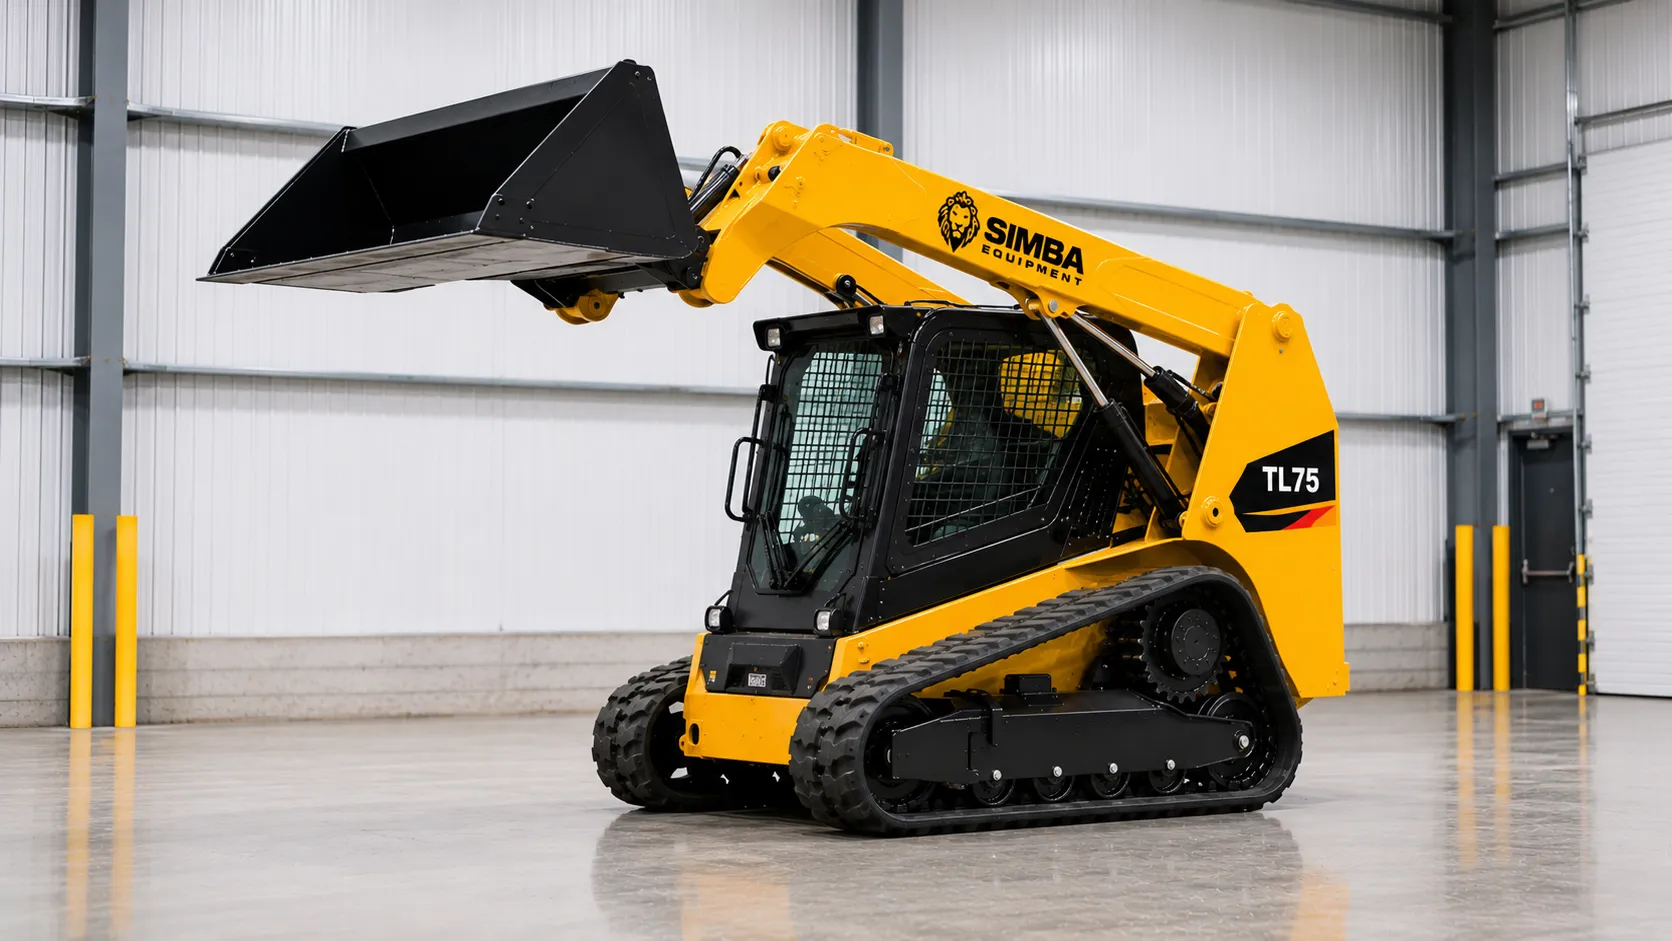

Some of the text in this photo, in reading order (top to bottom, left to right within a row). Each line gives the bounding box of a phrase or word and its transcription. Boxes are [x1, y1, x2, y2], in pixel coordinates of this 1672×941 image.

[981, 244, 1083, 286] EQUIPMENT
[984, 216, 1084, 275] SIMBA
[1262, 466, 1320, 493] TL75
